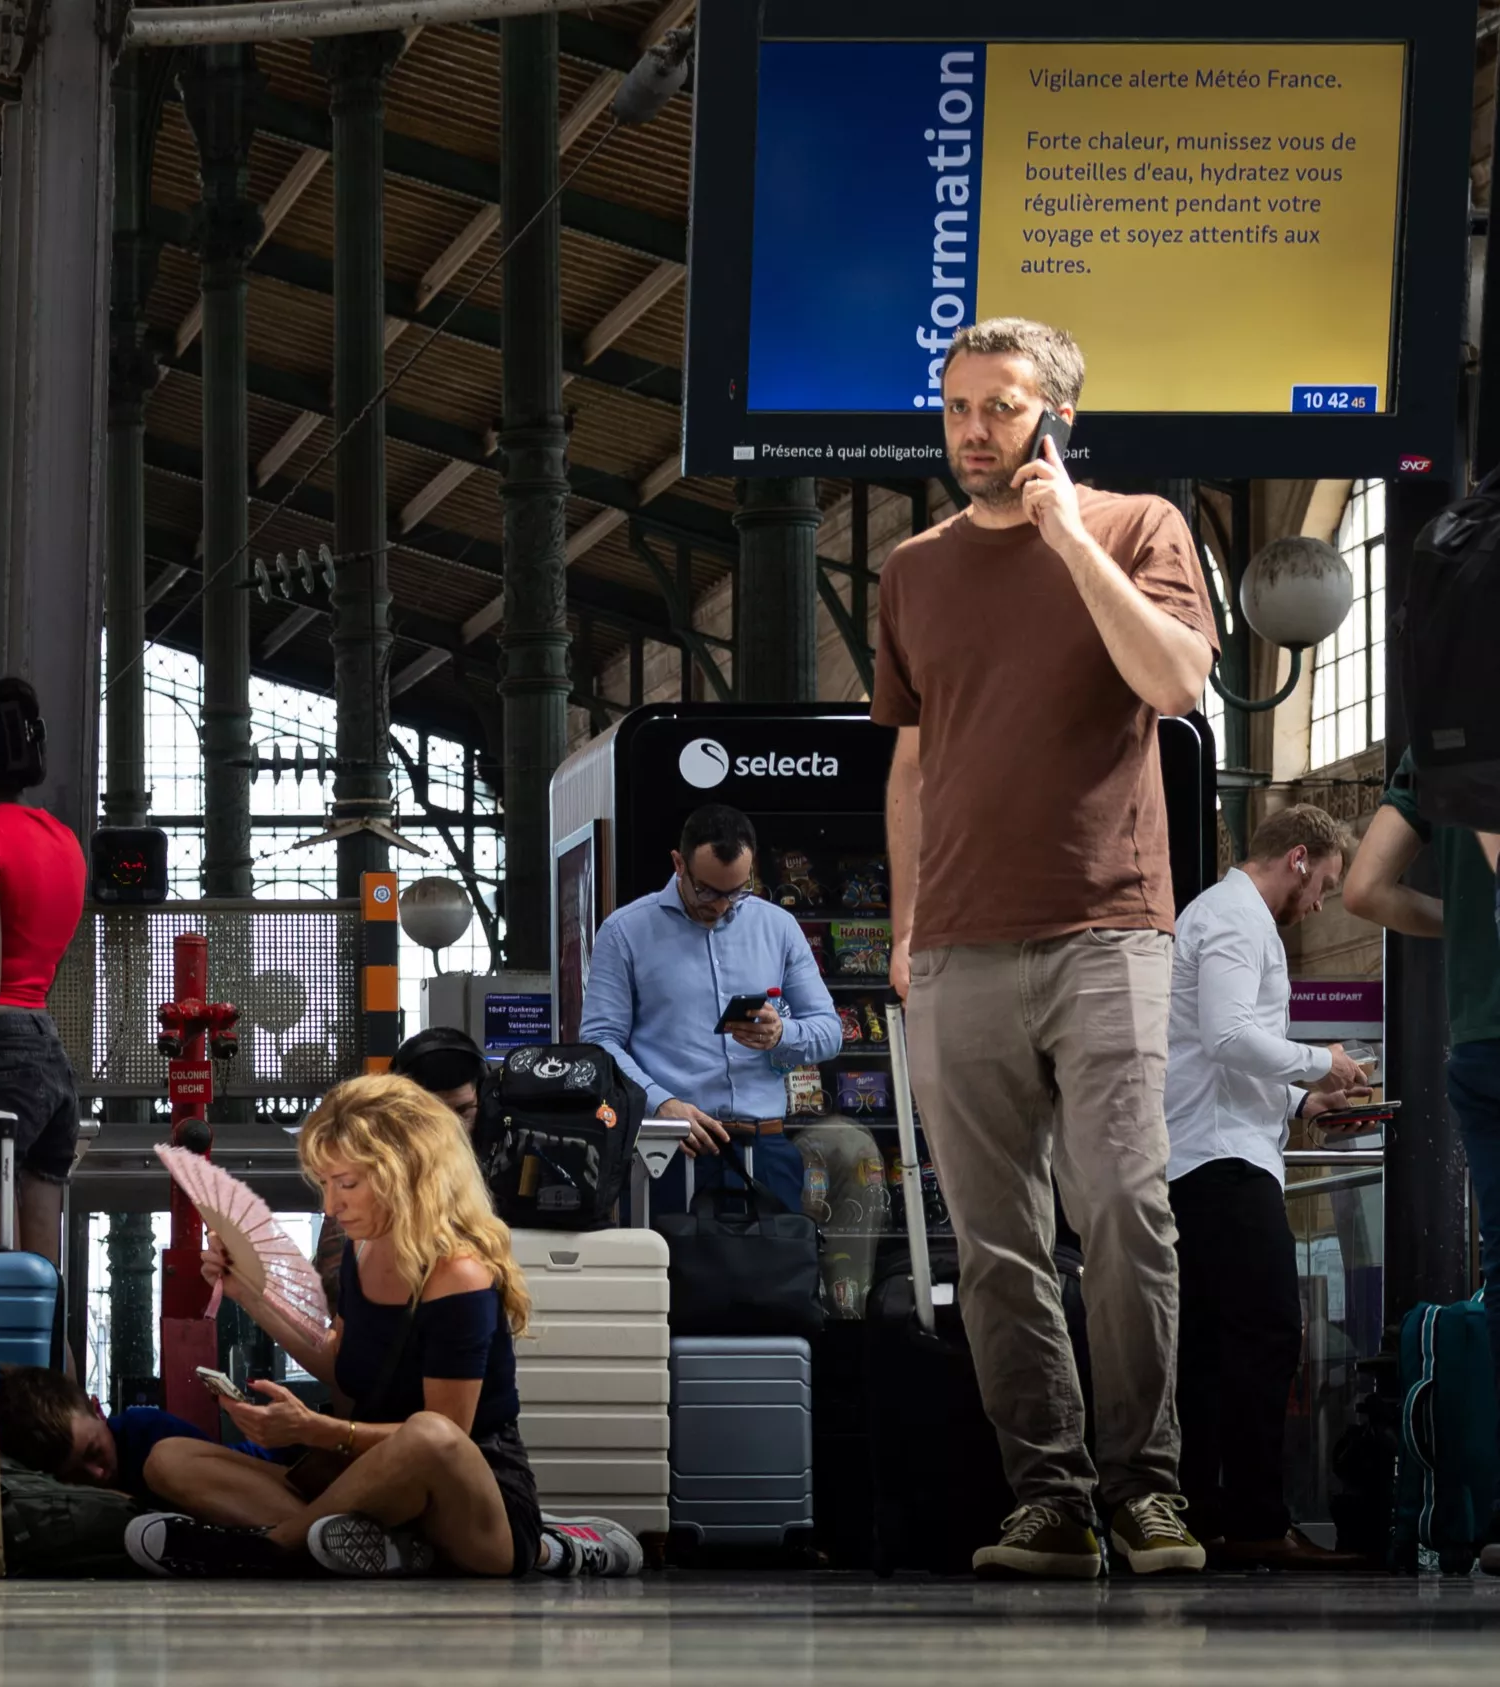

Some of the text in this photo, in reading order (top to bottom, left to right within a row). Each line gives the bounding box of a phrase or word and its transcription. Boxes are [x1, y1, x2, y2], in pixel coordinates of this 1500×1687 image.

[1029, 68, 1342, 93] Vigilance alerte Météo France.
[1027, 131, 1356, 154] Forte chaleur, munissez vous de
[1025, 162, 1343, 186] bouteilles d'eau, hydratez vous
[1024, 193, 1321, 217] régulièrement pendant votre
[1022, 224, 1320, 248] voyage et soyez attentifs aux
[1020, 256, 1091, 274] autres.
[1303, 392, 1366, 408] 10 42 45
[762, 443, 1091, 462] Présence à quai obligatoire part
[1399, 460, 1430, 471] SNCF
[733, 751, 839, 777] selecta
[840, 927, 886, 938] HARIBO
[1316, 993, 1327, 1001] LE
[1328, 992, 1363, 1001] DÉPART
[508, 1006, 544, 1014] Dunkerque
[171, 1070, 210, 1080] COLONNE
